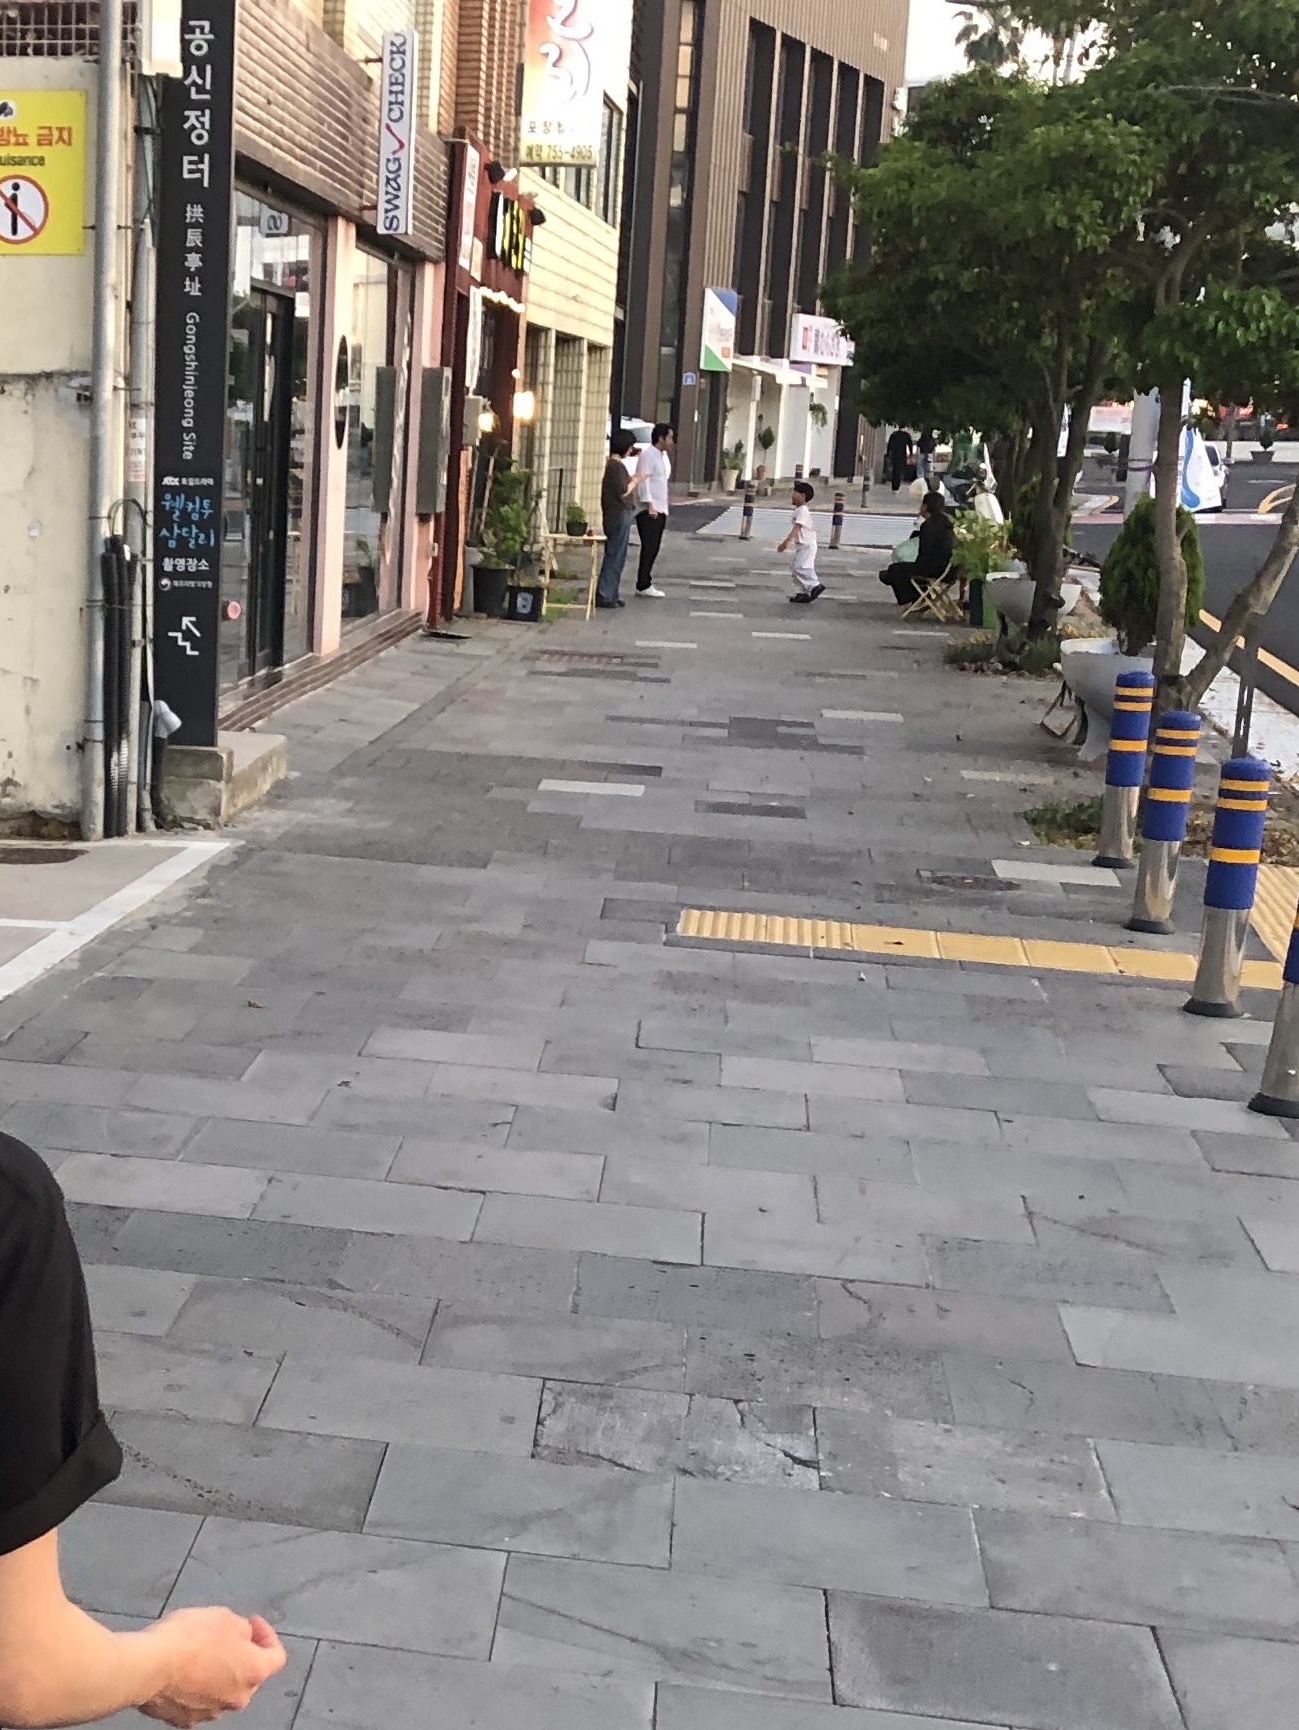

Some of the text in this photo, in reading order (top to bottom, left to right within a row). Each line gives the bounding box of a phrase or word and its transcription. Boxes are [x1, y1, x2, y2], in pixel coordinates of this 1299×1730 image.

[36, 125, 73, 147] 금지
[181, 19, 215, 188] 공신정터
[383, 32, 407, 232] SWAG CHECK
[181, 312, 200, 460] Gongshinjeong Site
[159, 523, 215, 549] 삼달리
[161, 493, 214, 521] 웰컴투
